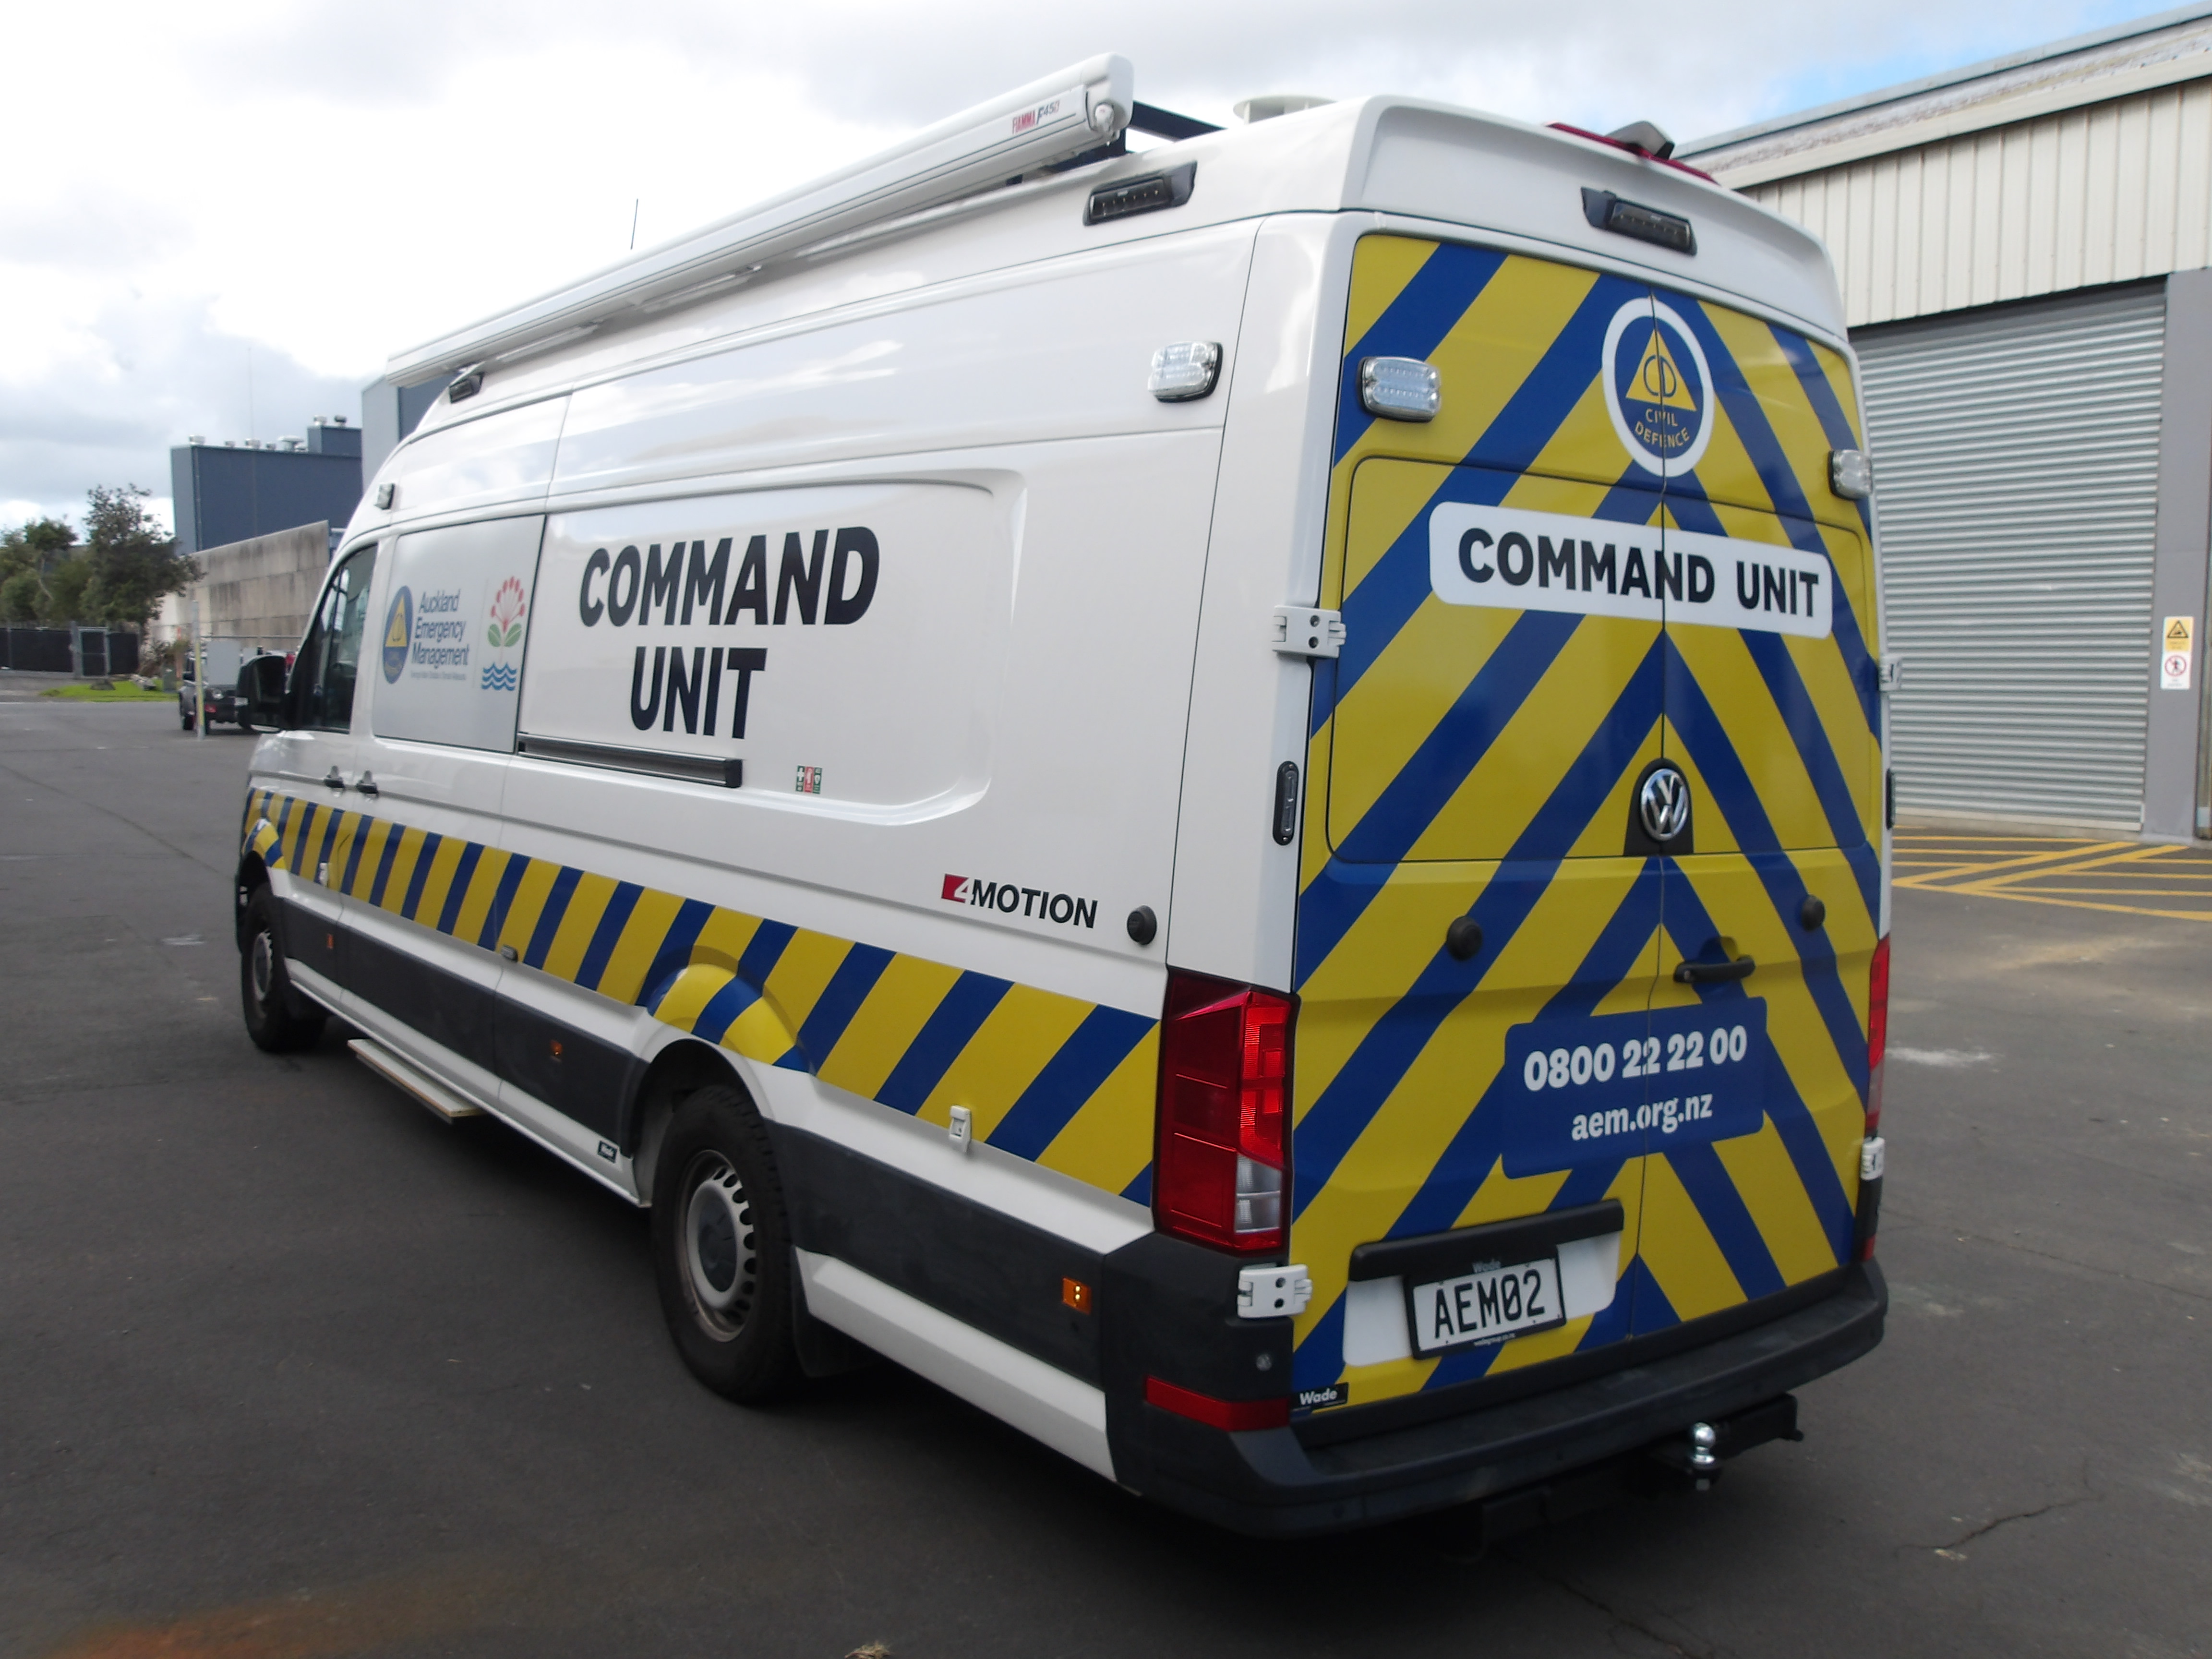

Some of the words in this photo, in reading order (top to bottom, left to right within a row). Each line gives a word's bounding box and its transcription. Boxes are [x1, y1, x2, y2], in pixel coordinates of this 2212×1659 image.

[1634, 421, 1690, 448] DEFENCE
[1646, 409, 1678, 427] CIVIL
[579, 526, 880, 627] COMMAND
[1458, 528, 1715, 603] COMMAND
[1736, 560, 1819, 617] UNIT
[419, 589, 461, 613] Auckland
[415, 616, 467, 643] Emergency
[411, 642, 469, 669] Management
[630, 646, 768, 739] UNIT
[953, 877, 1098, 929] 4MOTION
[1524, 1043, 1616, 1092] 0800
[1622, 1036, 1661, 1079] 22
[1667, 1031, 1705, 1071] 22
[1709, 1025, 1747, 1065] 00
[1571, 1094, 1713, 1141] aem.org.nz
[1434, 1269, 1545, 1339] AEM02
[1299, 1388, 1338, 1405] Wade
